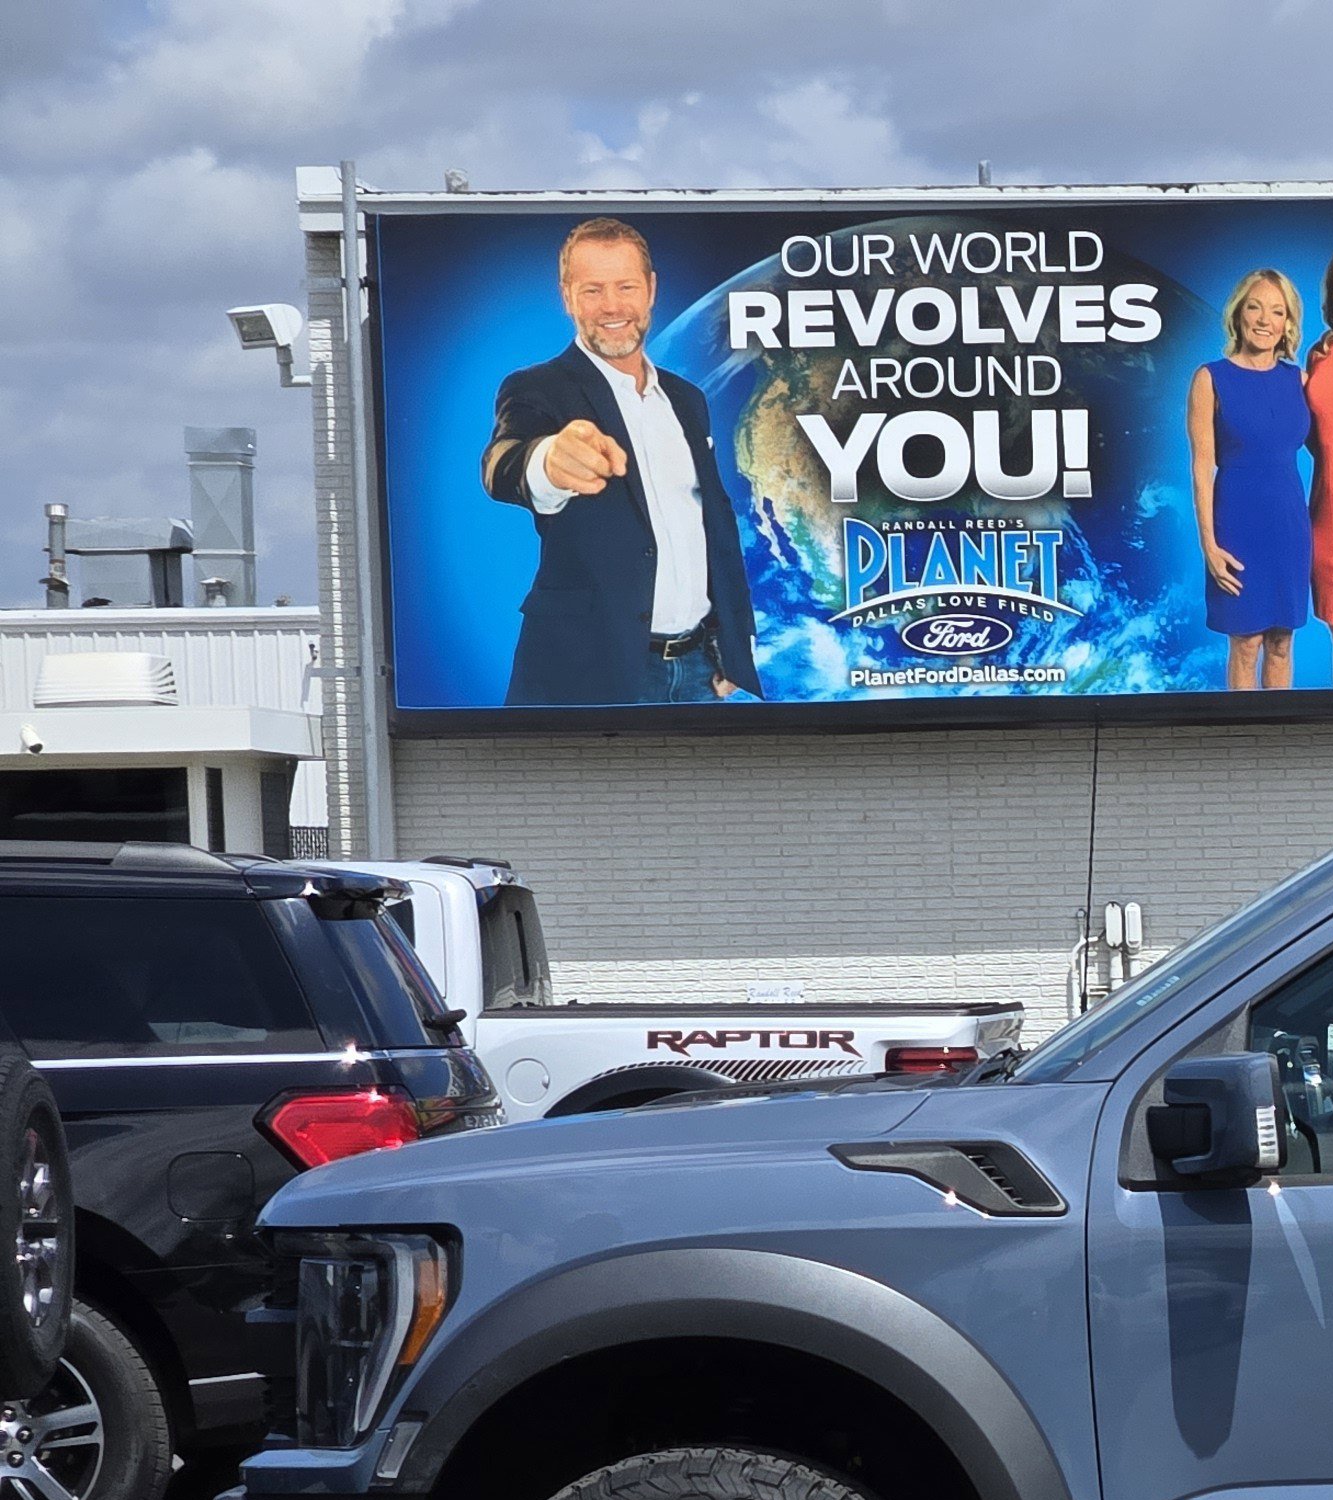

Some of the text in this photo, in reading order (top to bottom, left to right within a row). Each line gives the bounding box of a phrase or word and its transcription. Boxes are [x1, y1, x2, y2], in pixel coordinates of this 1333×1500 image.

[781, 231, 1103, 277] OUR WORLD
[728, 283, 1163, 350] REVOLVES
[832, 355, 1062, 400] AROUND
[796, 408, 1093, 502] YOU!
[882, 518, 1025, 531] RANDALL REED'S
[843, 518, 1063, 612] PLANET
[852, 595, 1054, 628] DALLAS LOVE FIELD
[923, 620, 991, 648] Ford
[851, 665, 1066, 687] PlanetFordDallas.com
[646, 1030, 862, 1058] RAPTOR
